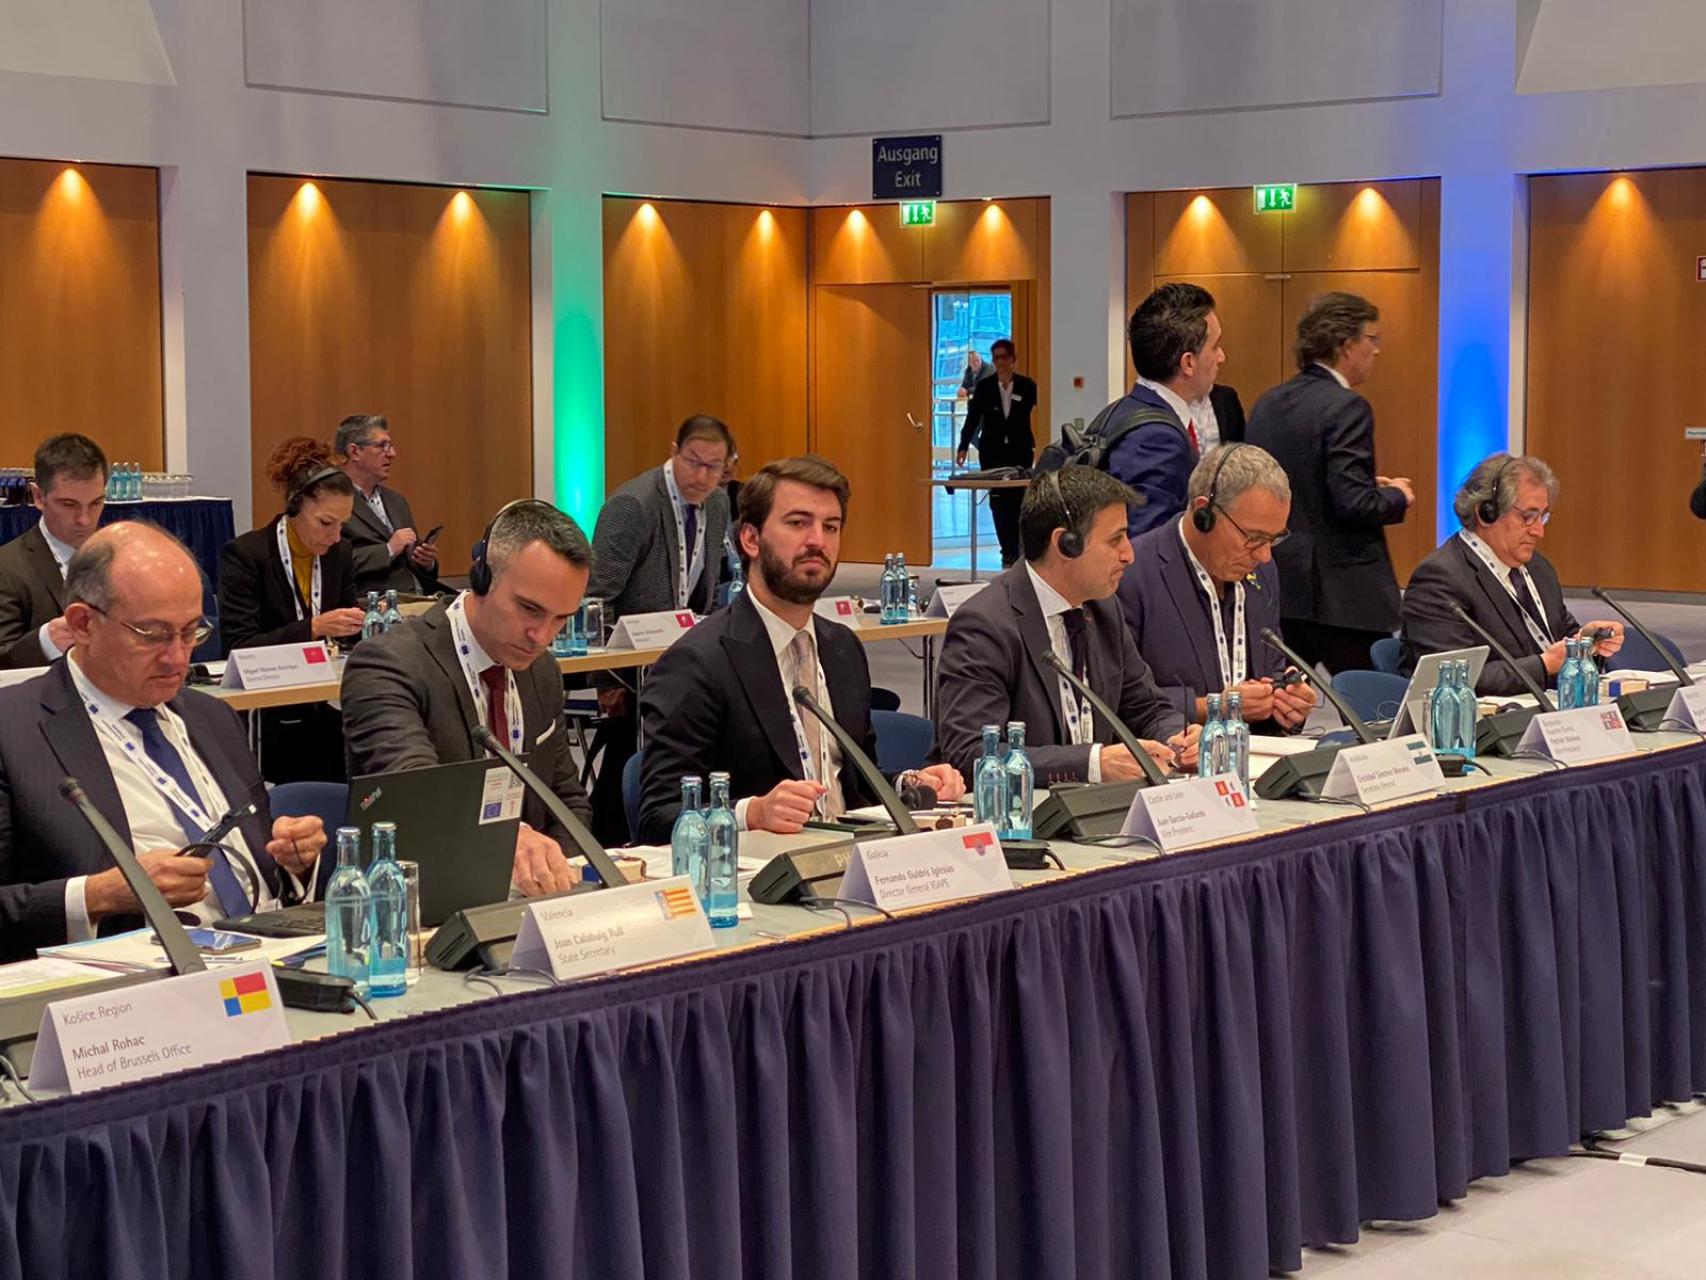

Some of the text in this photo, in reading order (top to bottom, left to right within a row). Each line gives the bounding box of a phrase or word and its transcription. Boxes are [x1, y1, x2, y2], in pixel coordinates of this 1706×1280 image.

[878, 146, 938, 165] Ausgang
[895, 170, 921, 187] Exit
[866, 847, 889, 860] Galicia
[874, 871, 906, 886] Fernando
[931, 863, 955, 878] Iglesias
[879, 886, 905, 900] Director
[905, 882, 930, 895] General
[540, 907, 573, 922] Valencia
[558, 945, 615, 965] State Secretary
[98, 1002, 132, 1018] Region
[72, 1035, 145, 1061] Michal Rohac
[77, 1043, 192, 1080] Head of Brussels Office
